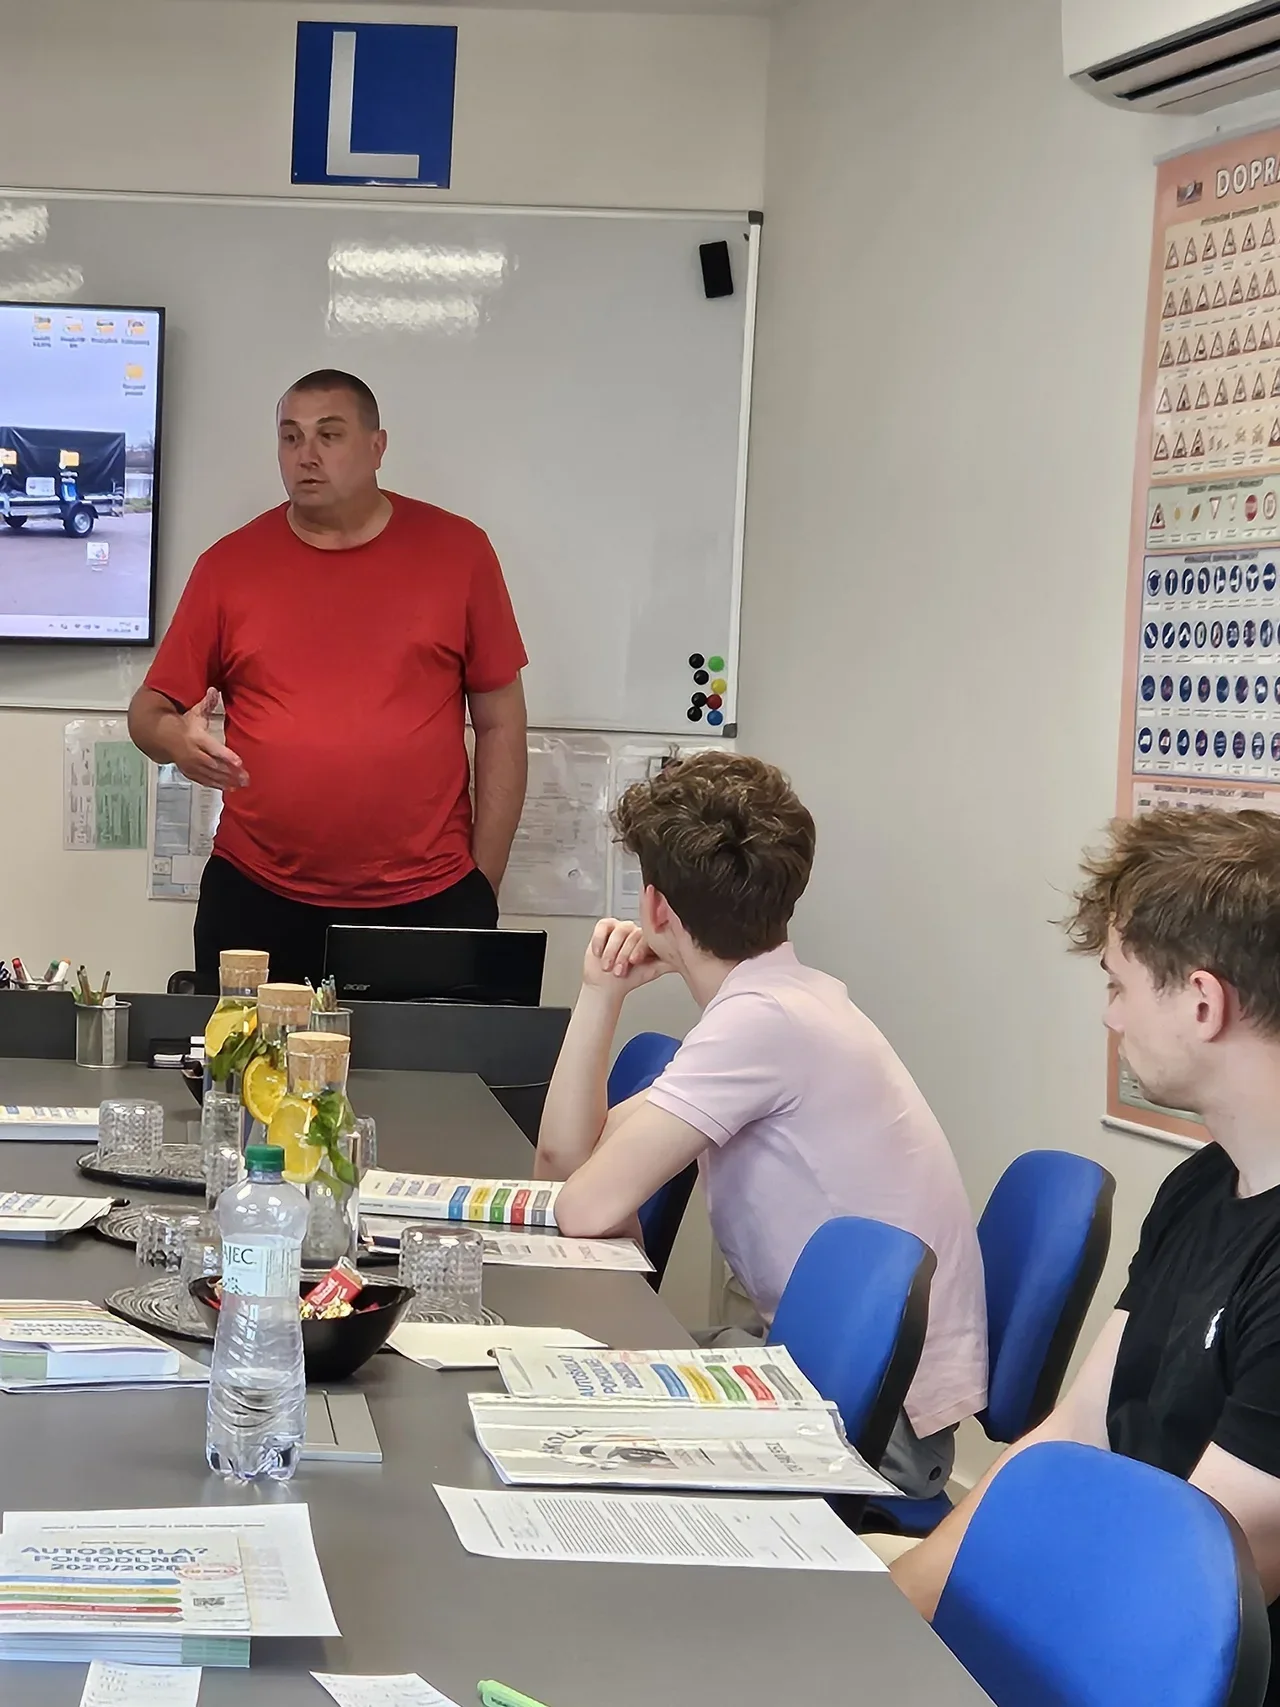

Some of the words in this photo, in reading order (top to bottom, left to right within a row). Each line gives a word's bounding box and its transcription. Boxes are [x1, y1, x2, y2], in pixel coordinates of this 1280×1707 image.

[326, 31, 419, 179] L
[1216, 156, 1280, 199] DOPR
[343, 983, 371, 991] acer
